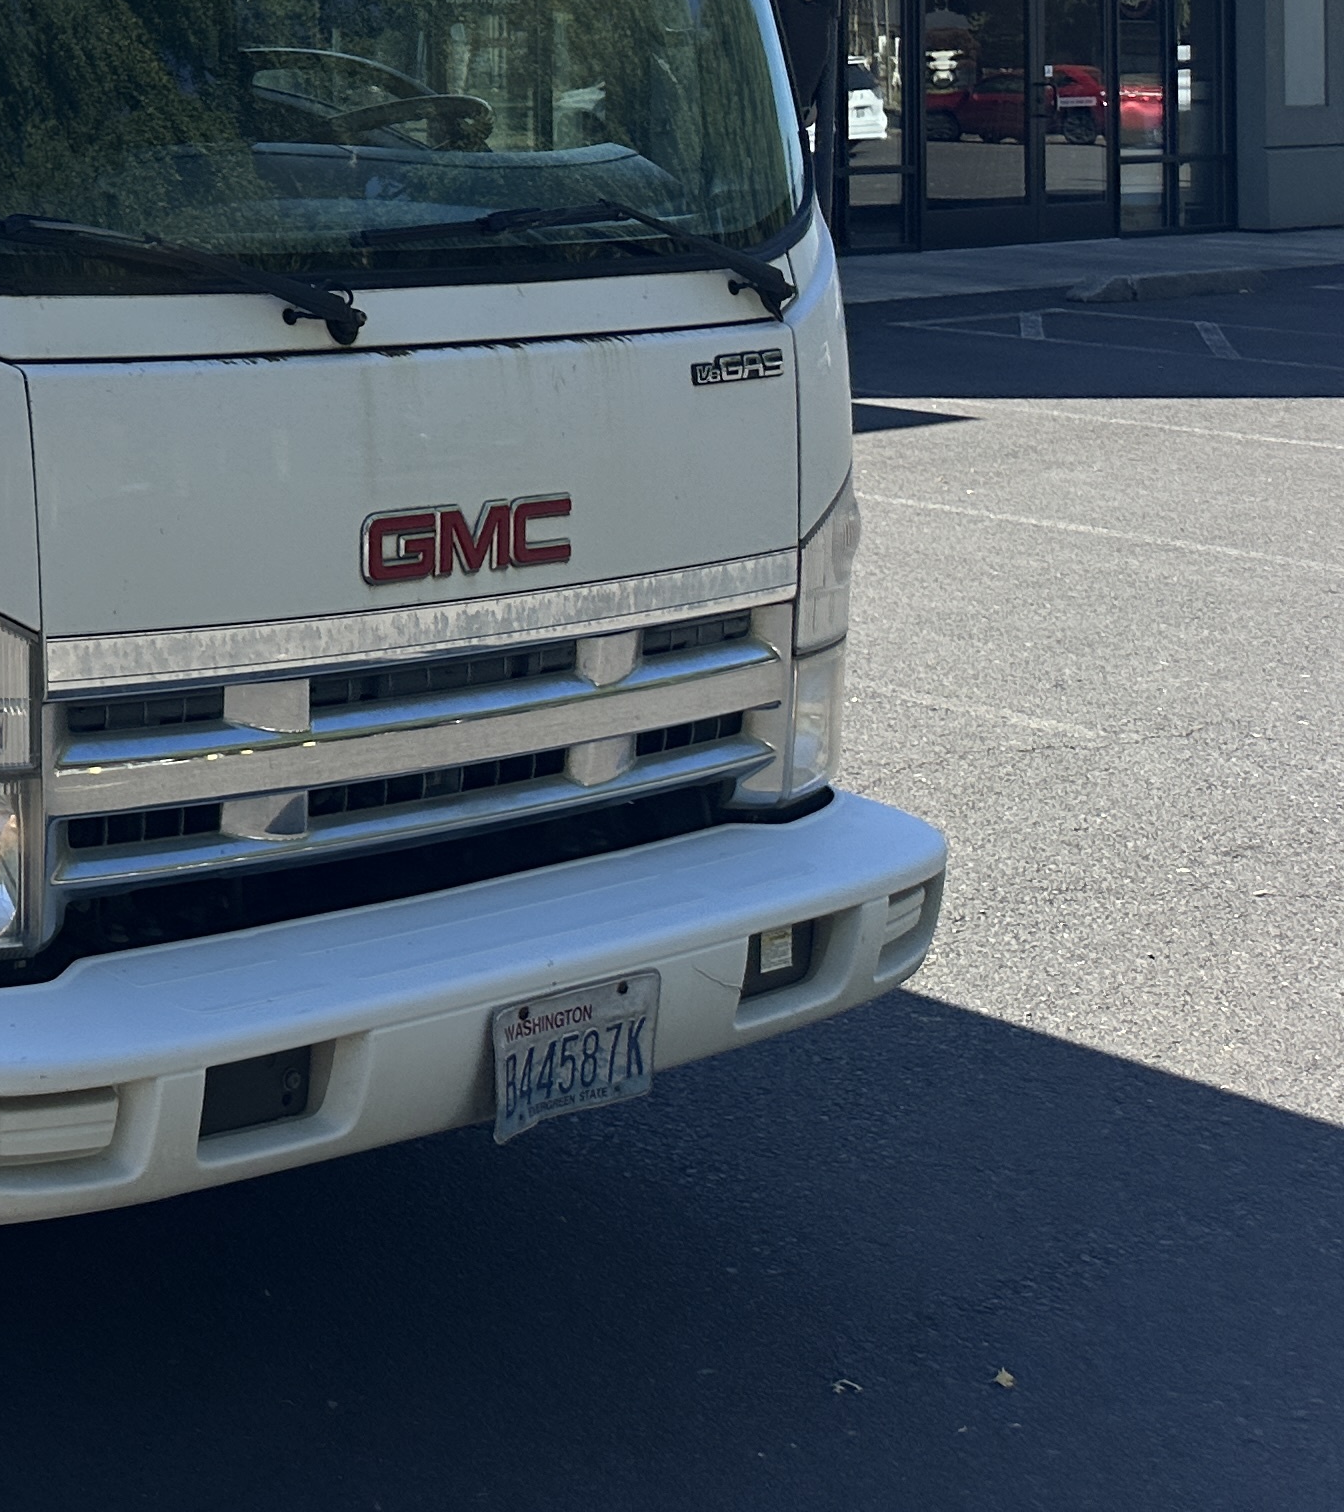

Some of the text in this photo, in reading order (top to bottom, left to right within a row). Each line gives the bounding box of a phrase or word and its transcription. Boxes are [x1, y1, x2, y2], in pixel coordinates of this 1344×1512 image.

[360, 491, 572, 586] GMC
[504, 1004, 593, 1045] WASHINGTON
[505, 1016, 647, 1120] B44587K
[579, 1087, 609, 1102] STATE
